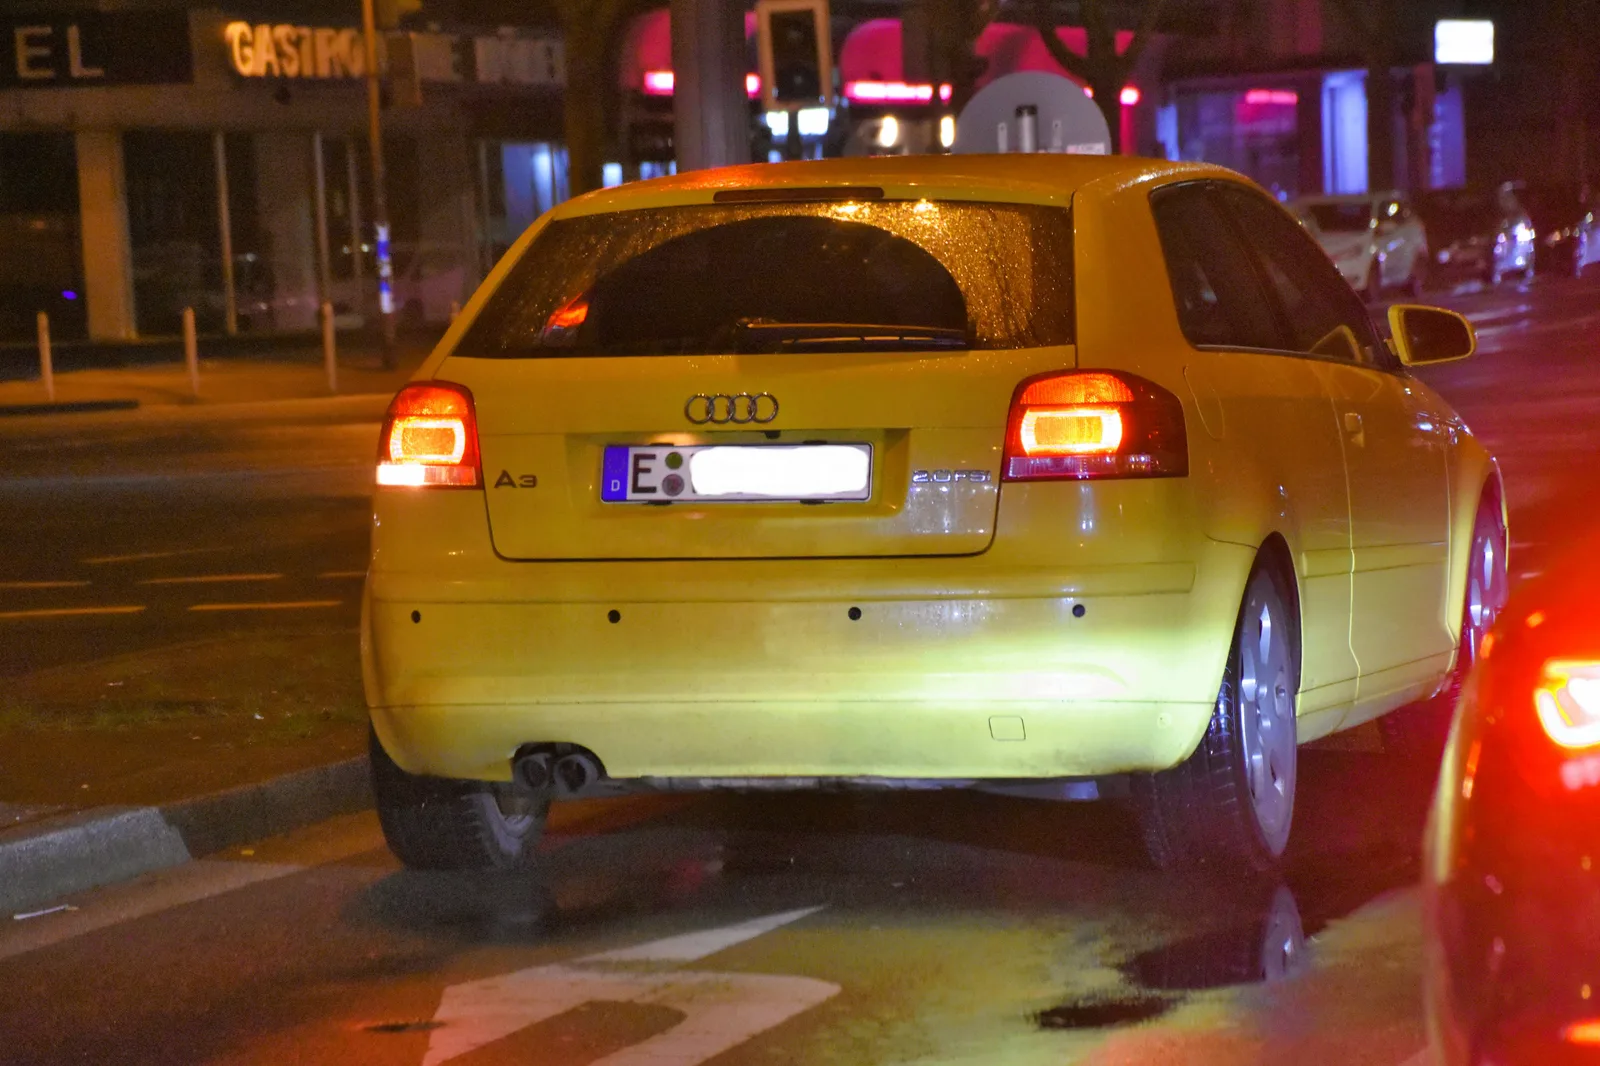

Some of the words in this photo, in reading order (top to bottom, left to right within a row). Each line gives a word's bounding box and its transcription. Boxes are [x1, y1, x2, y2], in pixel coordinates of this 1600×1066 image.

[14, 25, 105, 78] EL
[494, 469, 538, 489] A3
[610, 479, 621, 492] D
[631, 453, 657, 494] E
